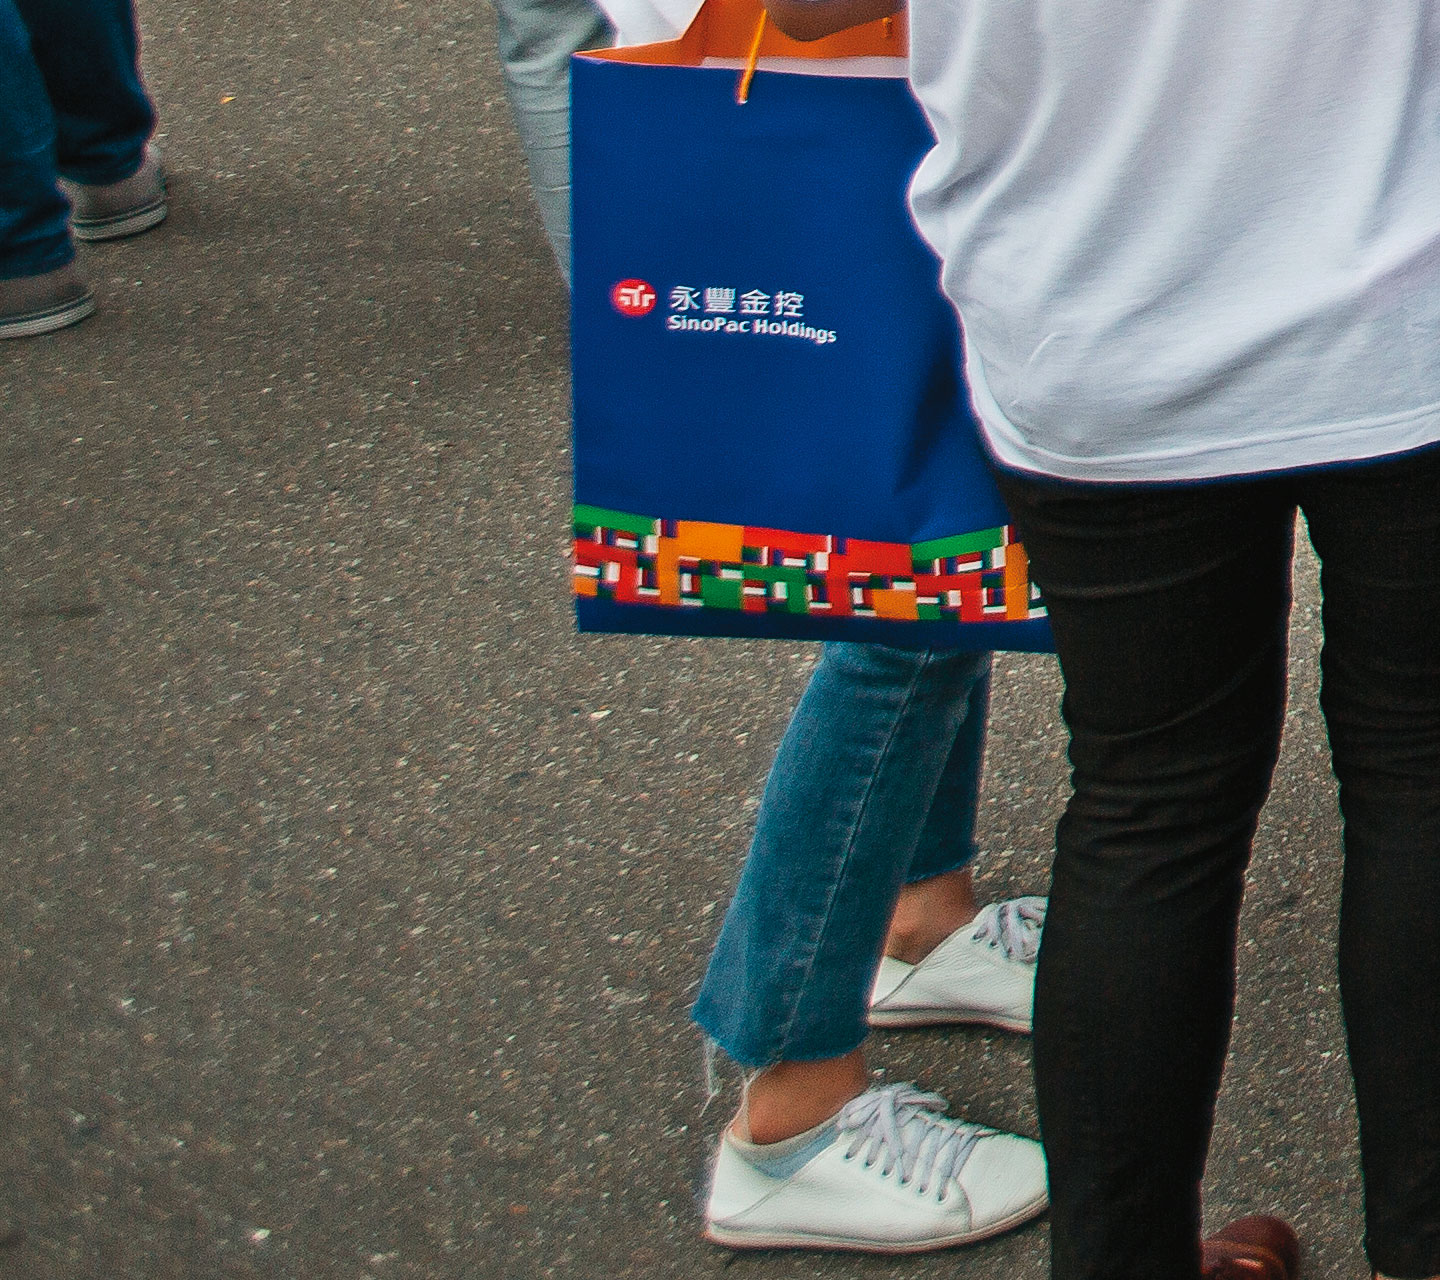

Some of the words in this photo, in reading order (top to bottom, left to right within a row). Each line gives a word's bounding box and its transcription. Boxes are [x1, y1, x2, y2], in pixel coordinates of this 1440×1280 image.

[669, 285, 804, 317] 永豐金控
[667, 313, 751, 334] SinoPac
[754, 318, 837, 345] Holdings
